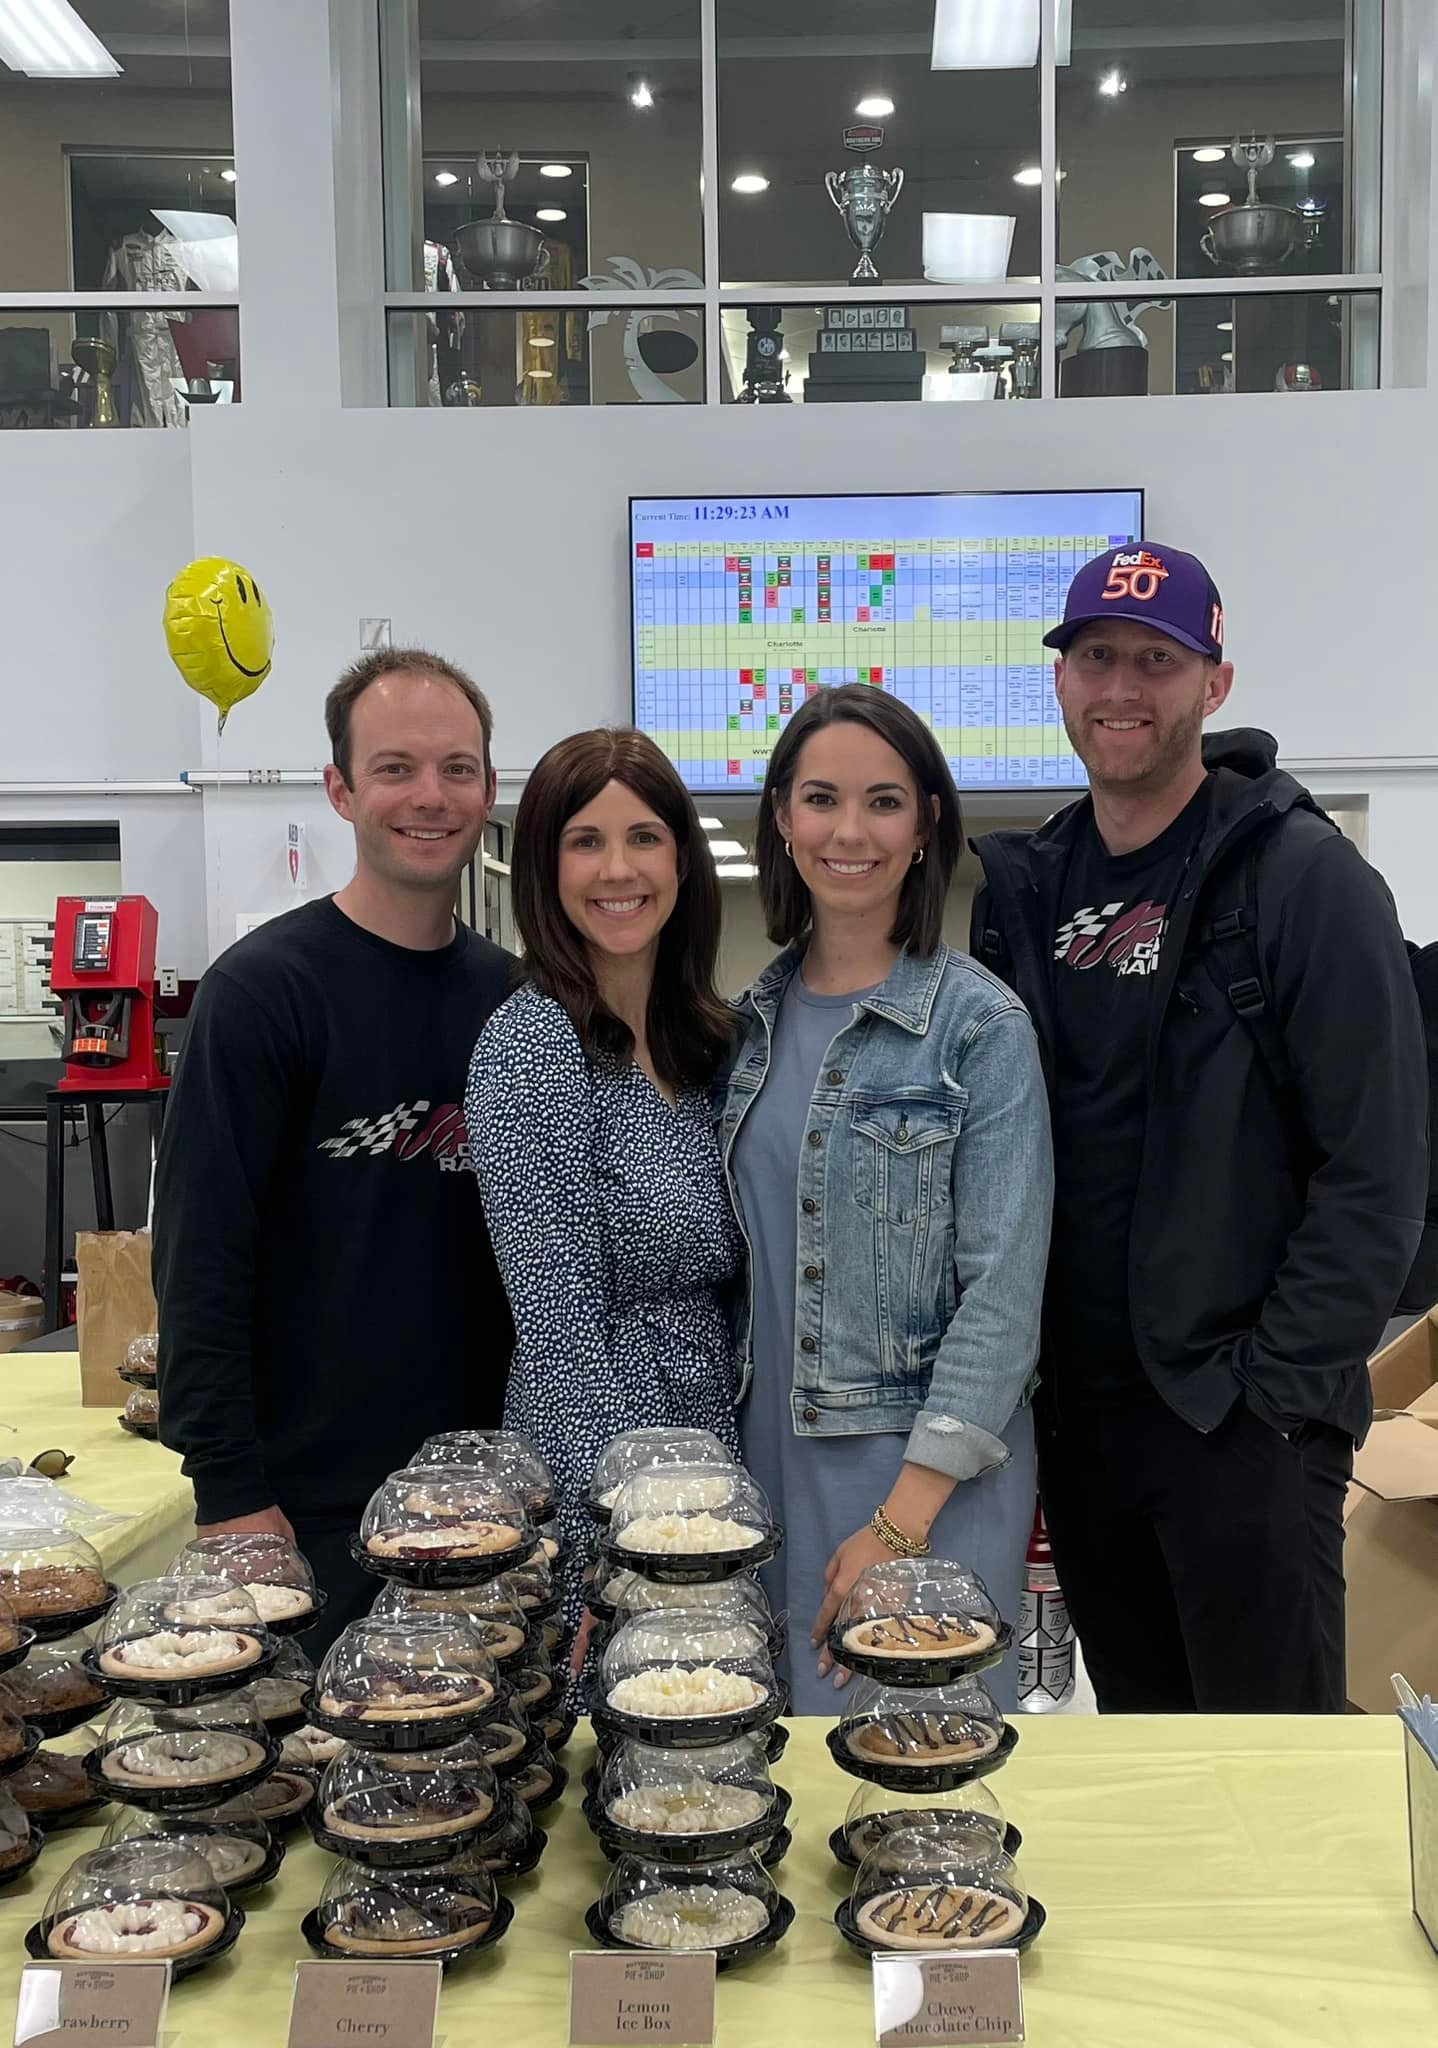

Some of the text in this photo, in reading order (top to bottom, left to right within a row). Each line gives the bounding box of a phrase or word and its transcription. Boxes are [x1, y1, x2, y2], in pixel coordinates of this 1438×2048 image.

[635, 513, 667, 521] Current
[694, 505, 757, 520] 11:29:23
[761, 505, 790, 520] AM
[1112, 550, 1163, 568] FedEx
[1101, 566, 1161, 600] 50
[767, 640, 803, 648] Charlotte
[618, 1999, 670, 2014] Lemon
[927, 2002, 976, 2019] Chewy
[55, 2014, 132, 2034] rawberry
[336, 2017, 389, 2038] Cherry
[616, 2015, 671, 2030] Ice Box
[975, 2016, 1012, 2034] Chip
